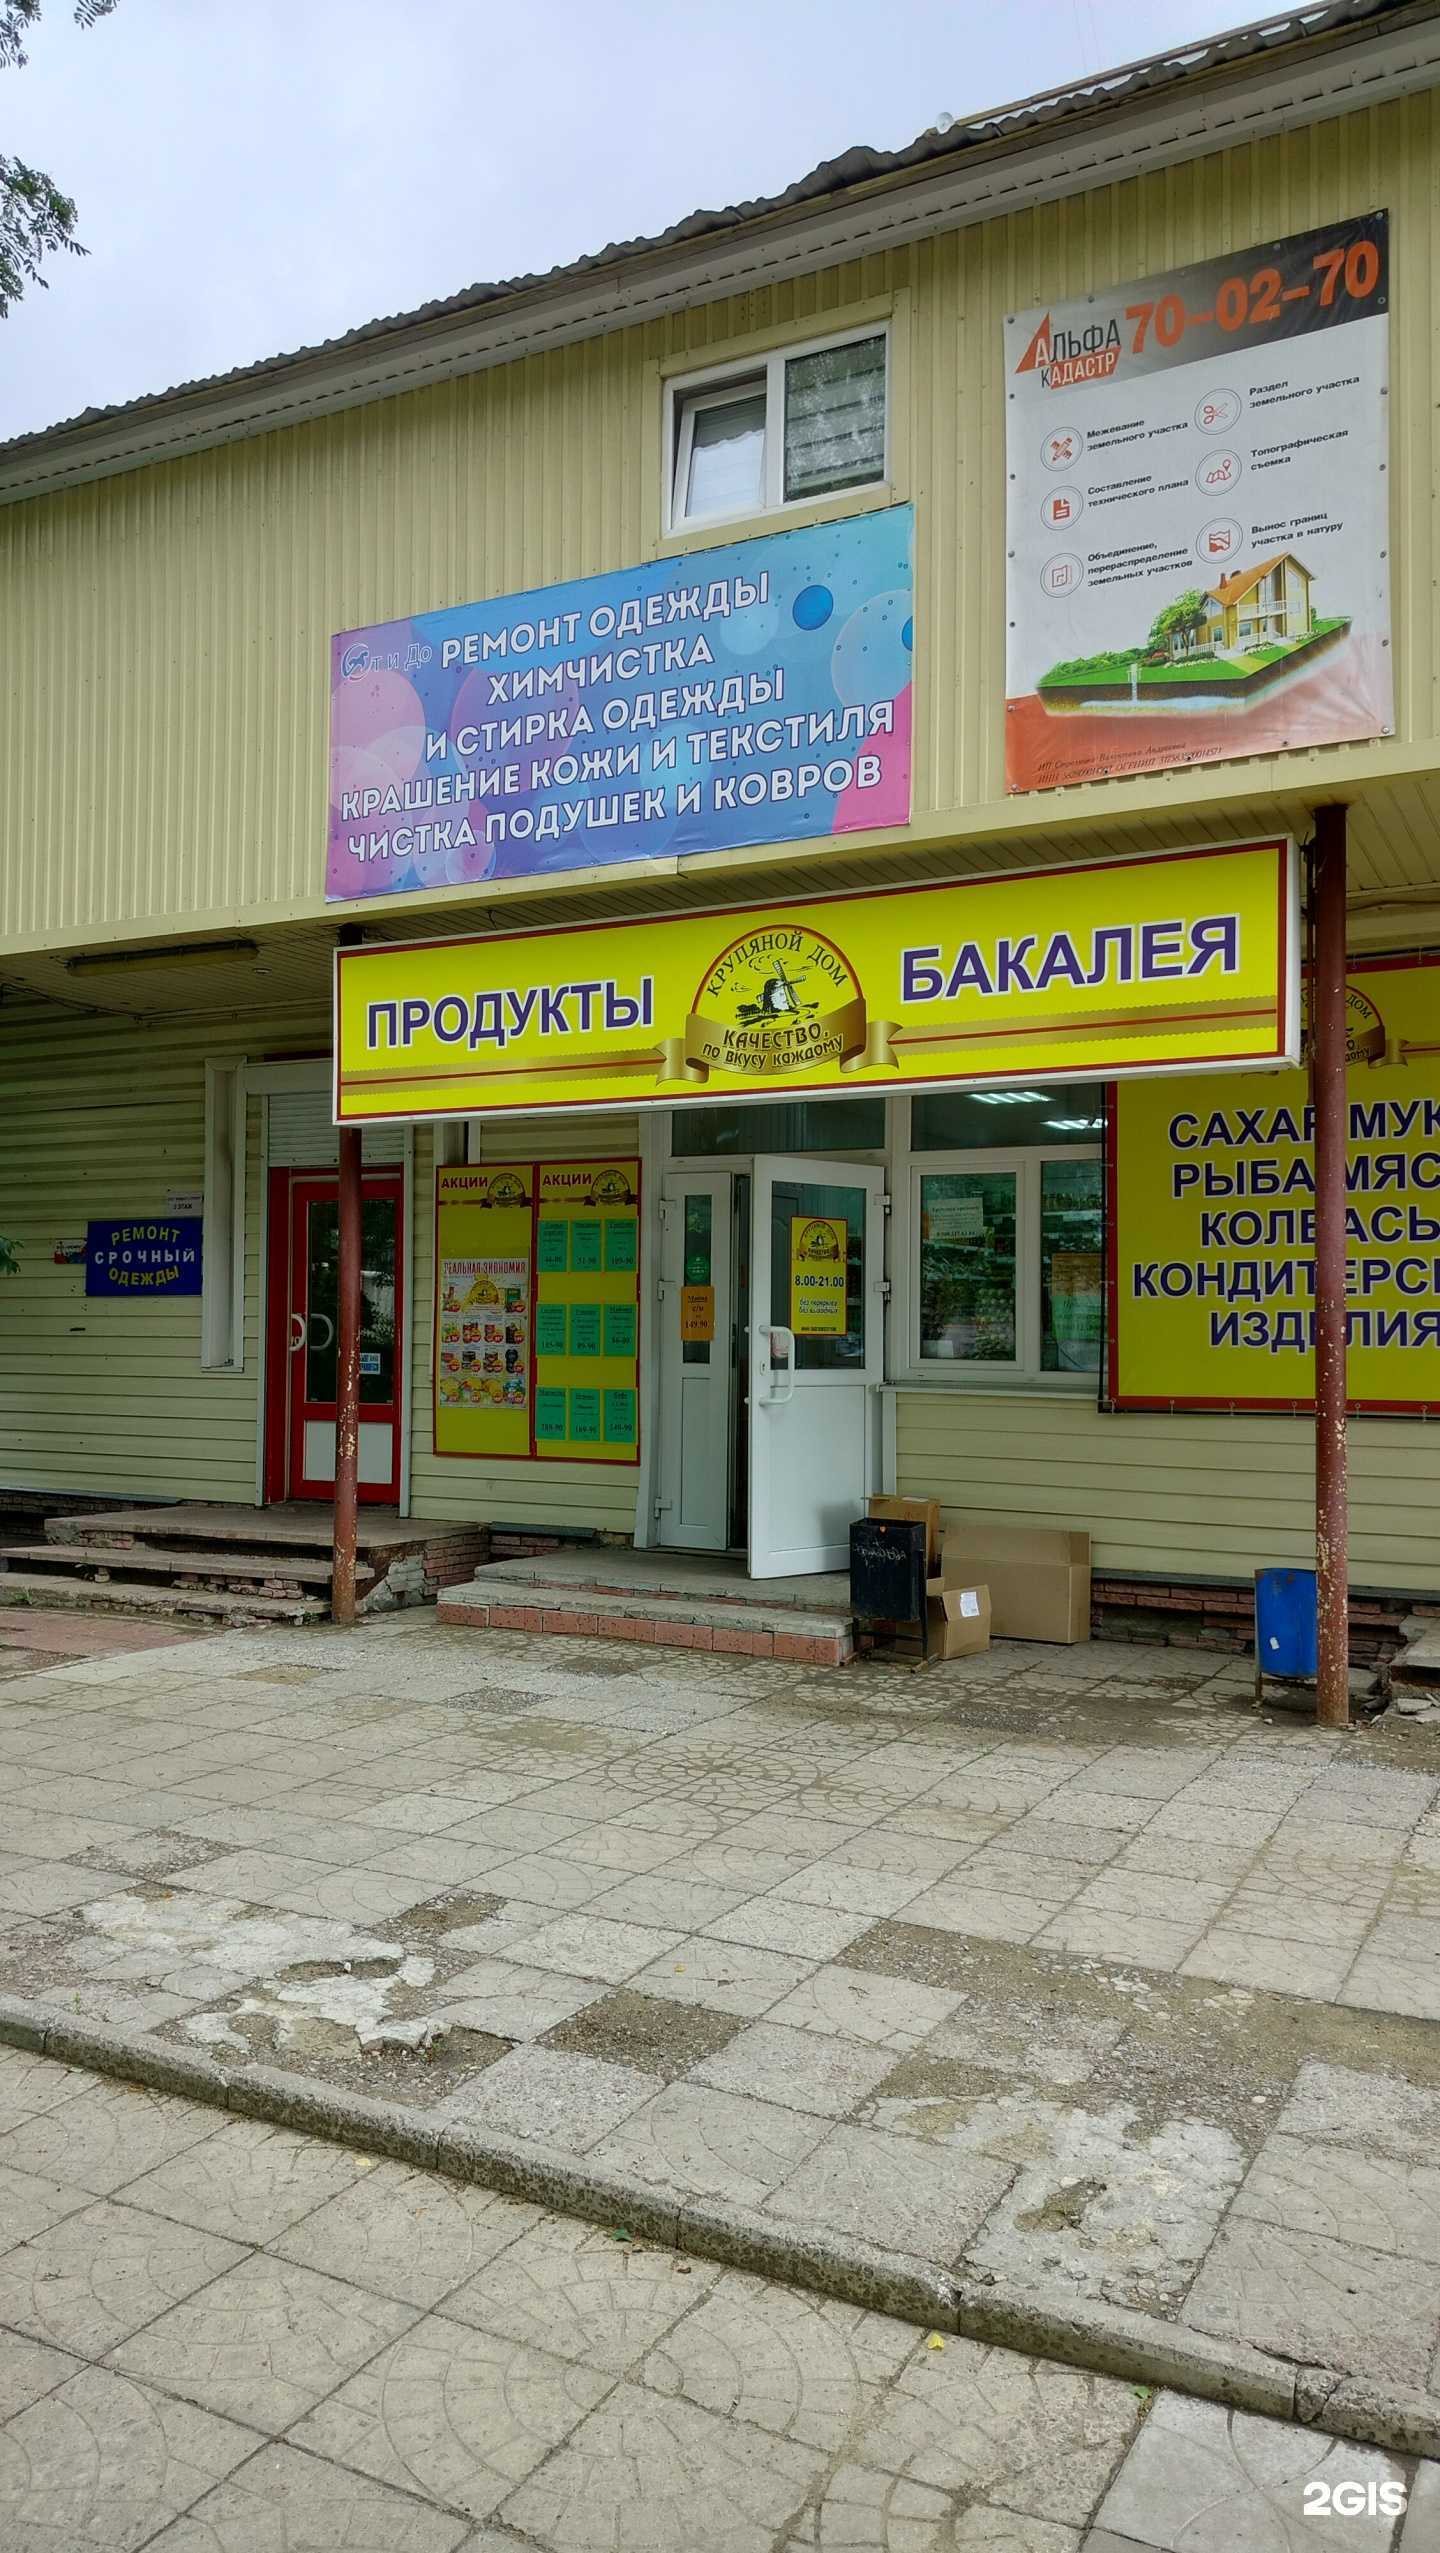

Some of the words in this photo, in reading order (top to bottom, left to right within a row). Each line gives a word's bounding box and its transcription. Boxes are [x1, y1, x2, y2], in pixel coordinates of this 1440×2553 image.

[1041, 352, 1115, 388] КАДАСТР
[1249, 379, 1289, 397] Раздел
[1249, 388, 1312, 409] земельного
[1316, 375, 1360, 396] участка
[1087, 419, 1145, 440] Межевание
[1087, 432, 1145, 452] земельного
[1148, 421, 1189, 440] участка
[1251, 429, 1349, 459] Топографическая
[1250, 455, 1292, 472] съемка
[1088, 474, 1152, 495] Составление
[1088, 486, 1155, 508] технического
[1158, 478, 1189, 494] плана
[1251, 520, 1286, 536] Вынос
[1290, 511, 1328, 528] границ
[1251, 531, 1293, 548] участка
[1307, 520, 1343, 537] натуру
[1088, 547, 1188, 575] перераспределение
[1088, 568, 1144, 587] земельных
[1147, 558, 1193, 577] участков
[441, 611, 581, 669] РЕМОНТ
[589, 571, 769, 640] ОДЕЖДЫ
[488, 634, 713, 706] ХИМЧИСТКА
[426, 733, 446, 763] И
[455, 705, 593, 758] СТИРКА
[603, 668, 784, 731] ОДЕЖДЫ
[341, 764, 521, 822] КРАШЕНИЕ
[531, 740, 640, 787] КОЖИ
[652, 736, 677, 770] И
[687, 700, 894, 764] ТЕКСТИЛЯ
[348, 813, 476, 863] ЧИСТКА
[485, 787, 665, 842] ПОДУШЕК
[677, 781, 701, 815] И
[713, 755, 881, 811] КОВРОВ
[707, 931, 803, 997] КРУПЯНОЙ
[807, 944, 848, 987] ДОМ
[901, 914, 1238, 1003] БАКАЛЕЯ
[367, 976, 654, 1051] ПРОДУКТЫ
[441, 1176, 488, 1190] АКЦИИ
[542, 1173, 592, 1187] АКЦИИ
[1173, 1157, 1316, 1197] РЫБА
[111, 1225, 181, 1246] РЕМОНТ
[95, 1248, 196, 1265] СРОЧНЫЙ
[109, 1265, 180, 1287] ОДЕЖДЫ
[794, 1275, 845, 1288] 8.00-21.00
